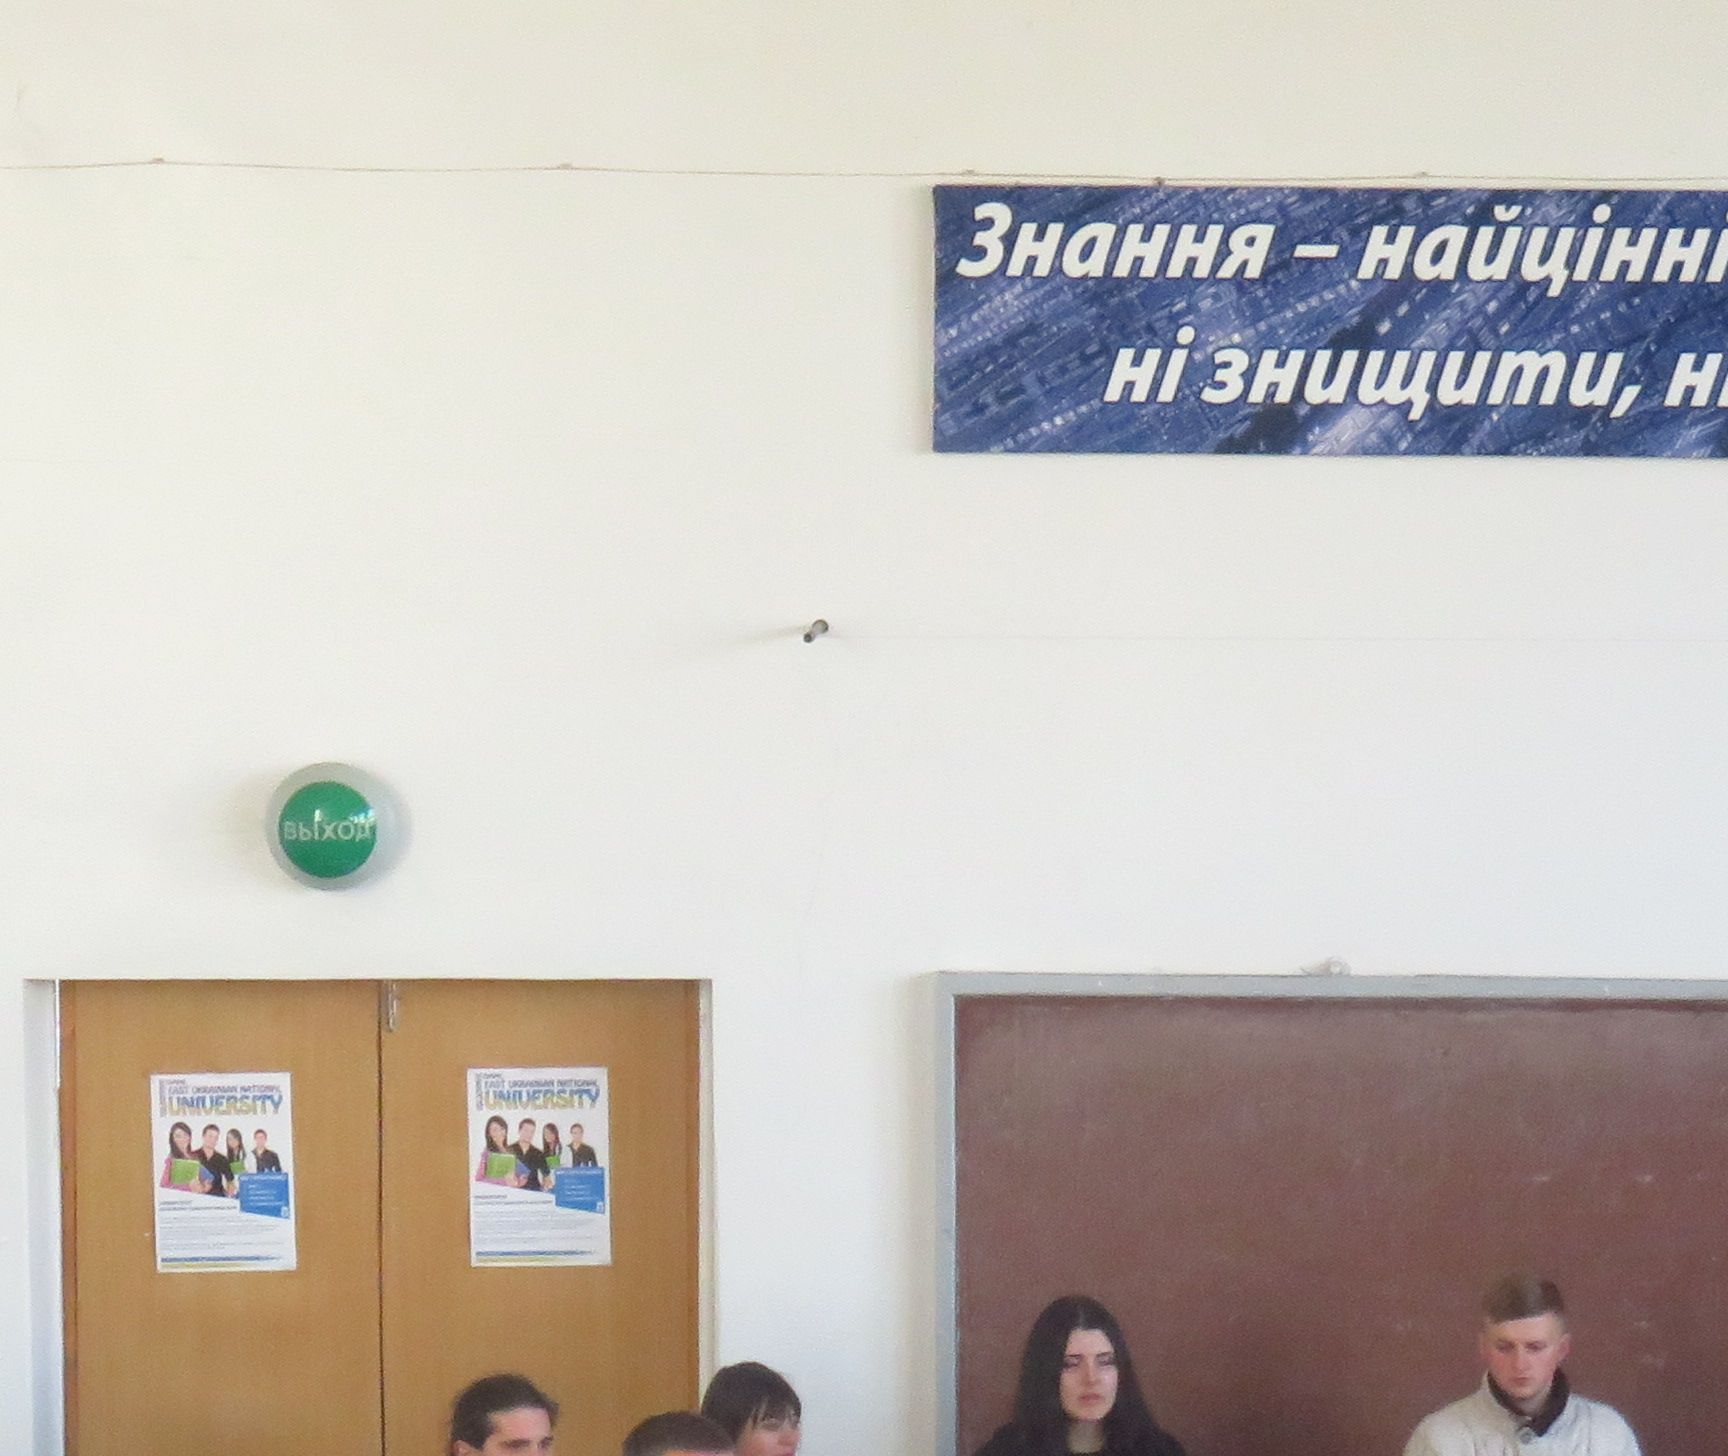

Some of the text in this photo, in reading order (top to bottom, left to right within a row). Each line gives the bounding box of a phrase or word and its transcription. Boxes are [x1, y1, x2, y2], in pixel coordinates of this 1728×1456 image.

[954, 201, 1276, 280] Знання
[1293, 244, 1339, 258] –
[1102, 325, 1196, 404] ні
[1199, 349, 1642, 421] знищити,
[168, 1094, 284, 1116] UNIVERSITY
[484, 1088, 601, 1110] UNIVERSITY
